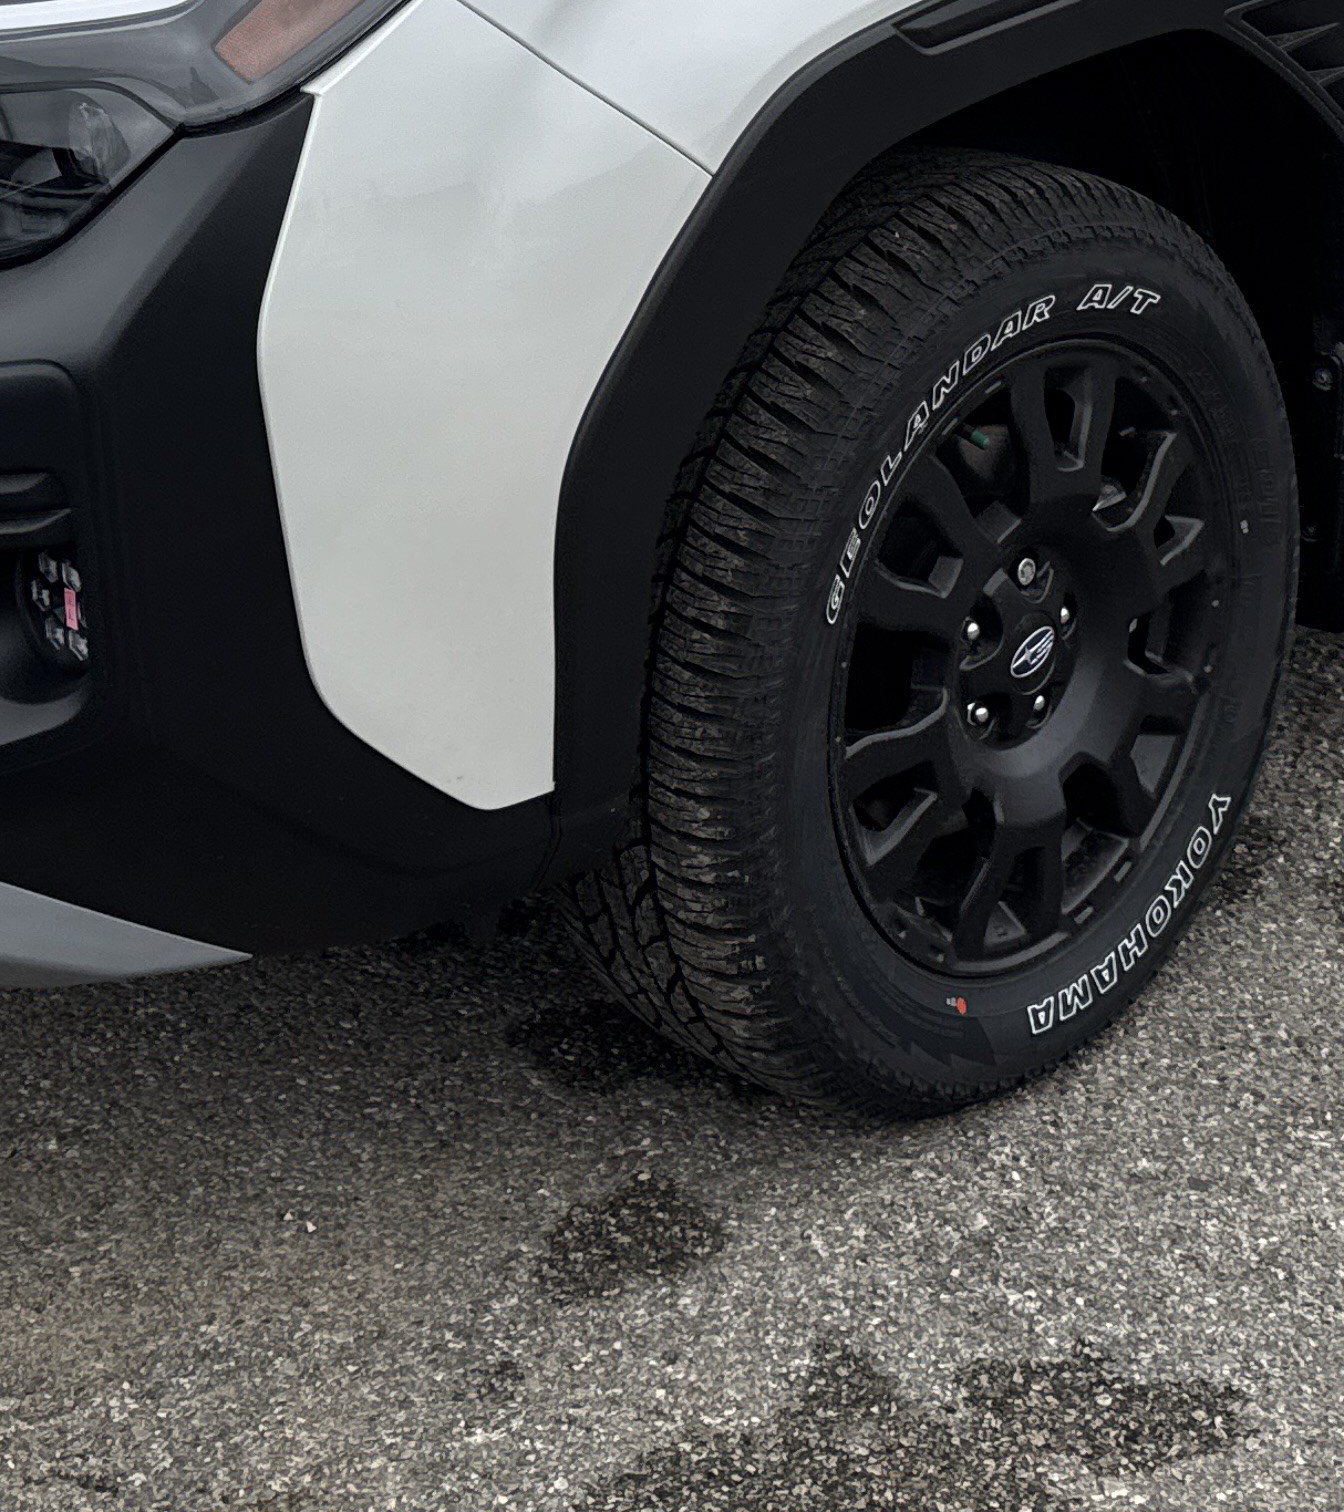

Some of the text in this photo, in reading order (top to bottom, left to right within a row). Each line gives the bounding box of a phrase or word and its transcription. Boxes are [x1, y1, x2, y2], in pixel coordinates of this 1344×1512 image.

[826, 283, 1162, 625] GEOLANDAR A/T
[1027, 793, 1232, 1035] YOKOHAMA
